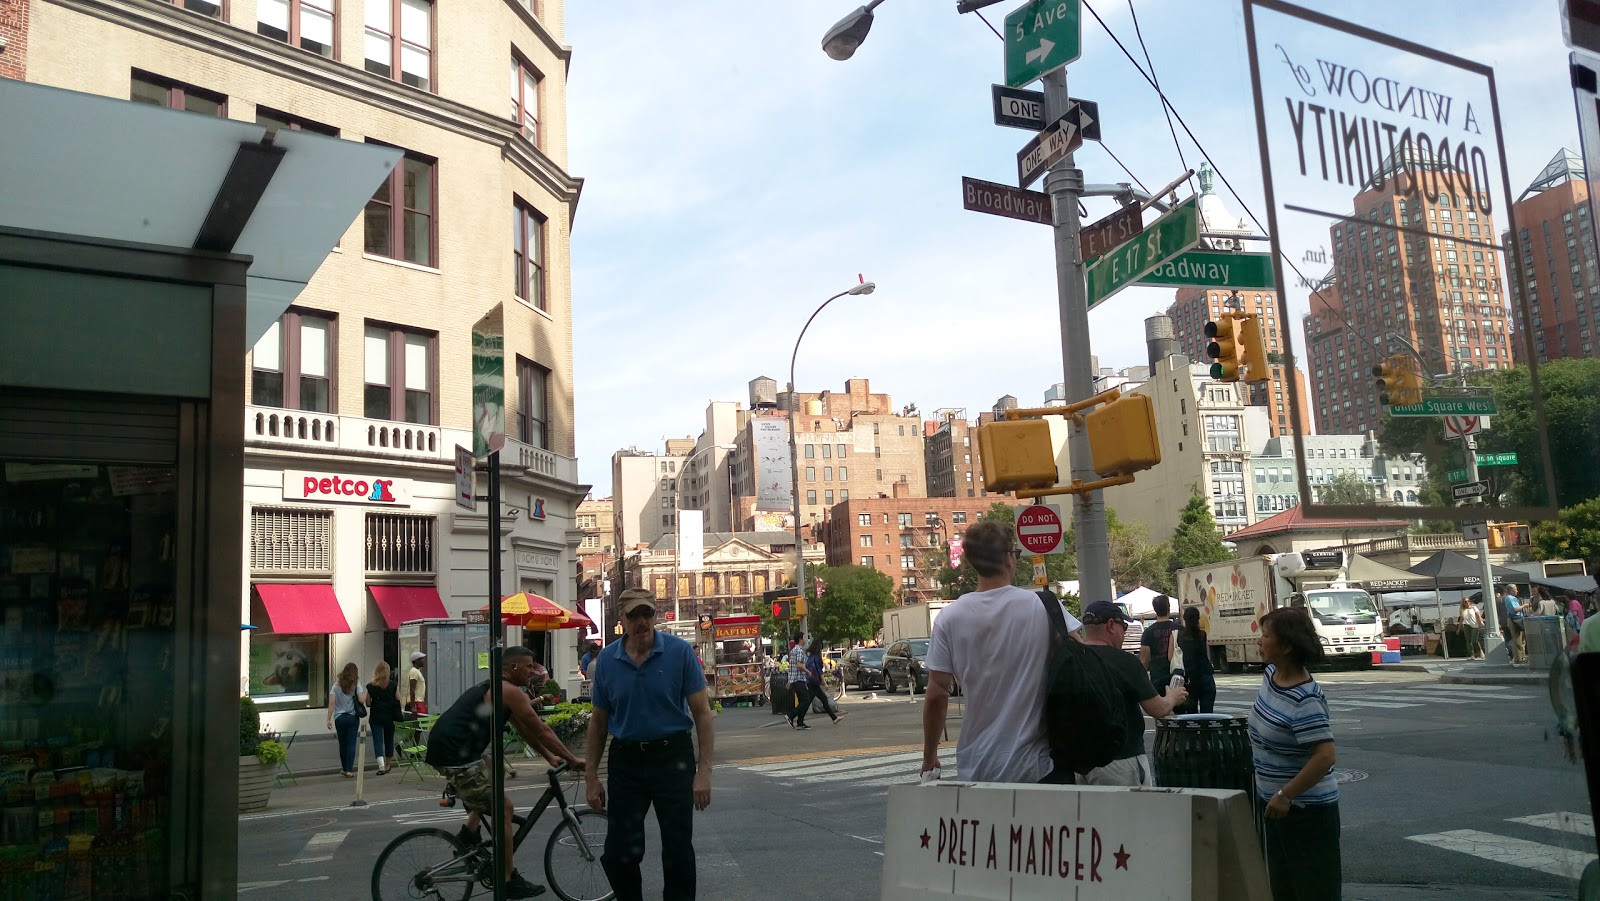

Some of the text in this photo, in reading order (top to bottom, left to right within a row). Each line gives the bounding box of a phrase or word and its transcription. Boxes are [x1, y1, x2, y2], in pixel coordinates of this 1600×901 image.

[1016, 2, 1067, 42] 5 Ave
[1010, 100, 1041, 119] ONE
[1025, 123, 1071, 174] ONE WAY
[966, 183, 1044, 222] Broadway
[1089, 233, 1097, 255] E
[1100, 224, 1113, 248] 17
[1118, 214, 1133, 240] St
[1112, 228, 1163, 285] E 17 St
[1153, 258, 1230, 285] oadway
[1427, 400, 1463, 413] Square
[303, 475, 369, 498] petco
[1457, 485, 1484, 496] ONE WAY
[1022, 513, 1055, 525] DO NOT
[1027, 534, 1054, 546] ENTER
[1217, 589, 1255, 603] RED JACKET
[937, 816, 1102, 883] PRET A MANGER
